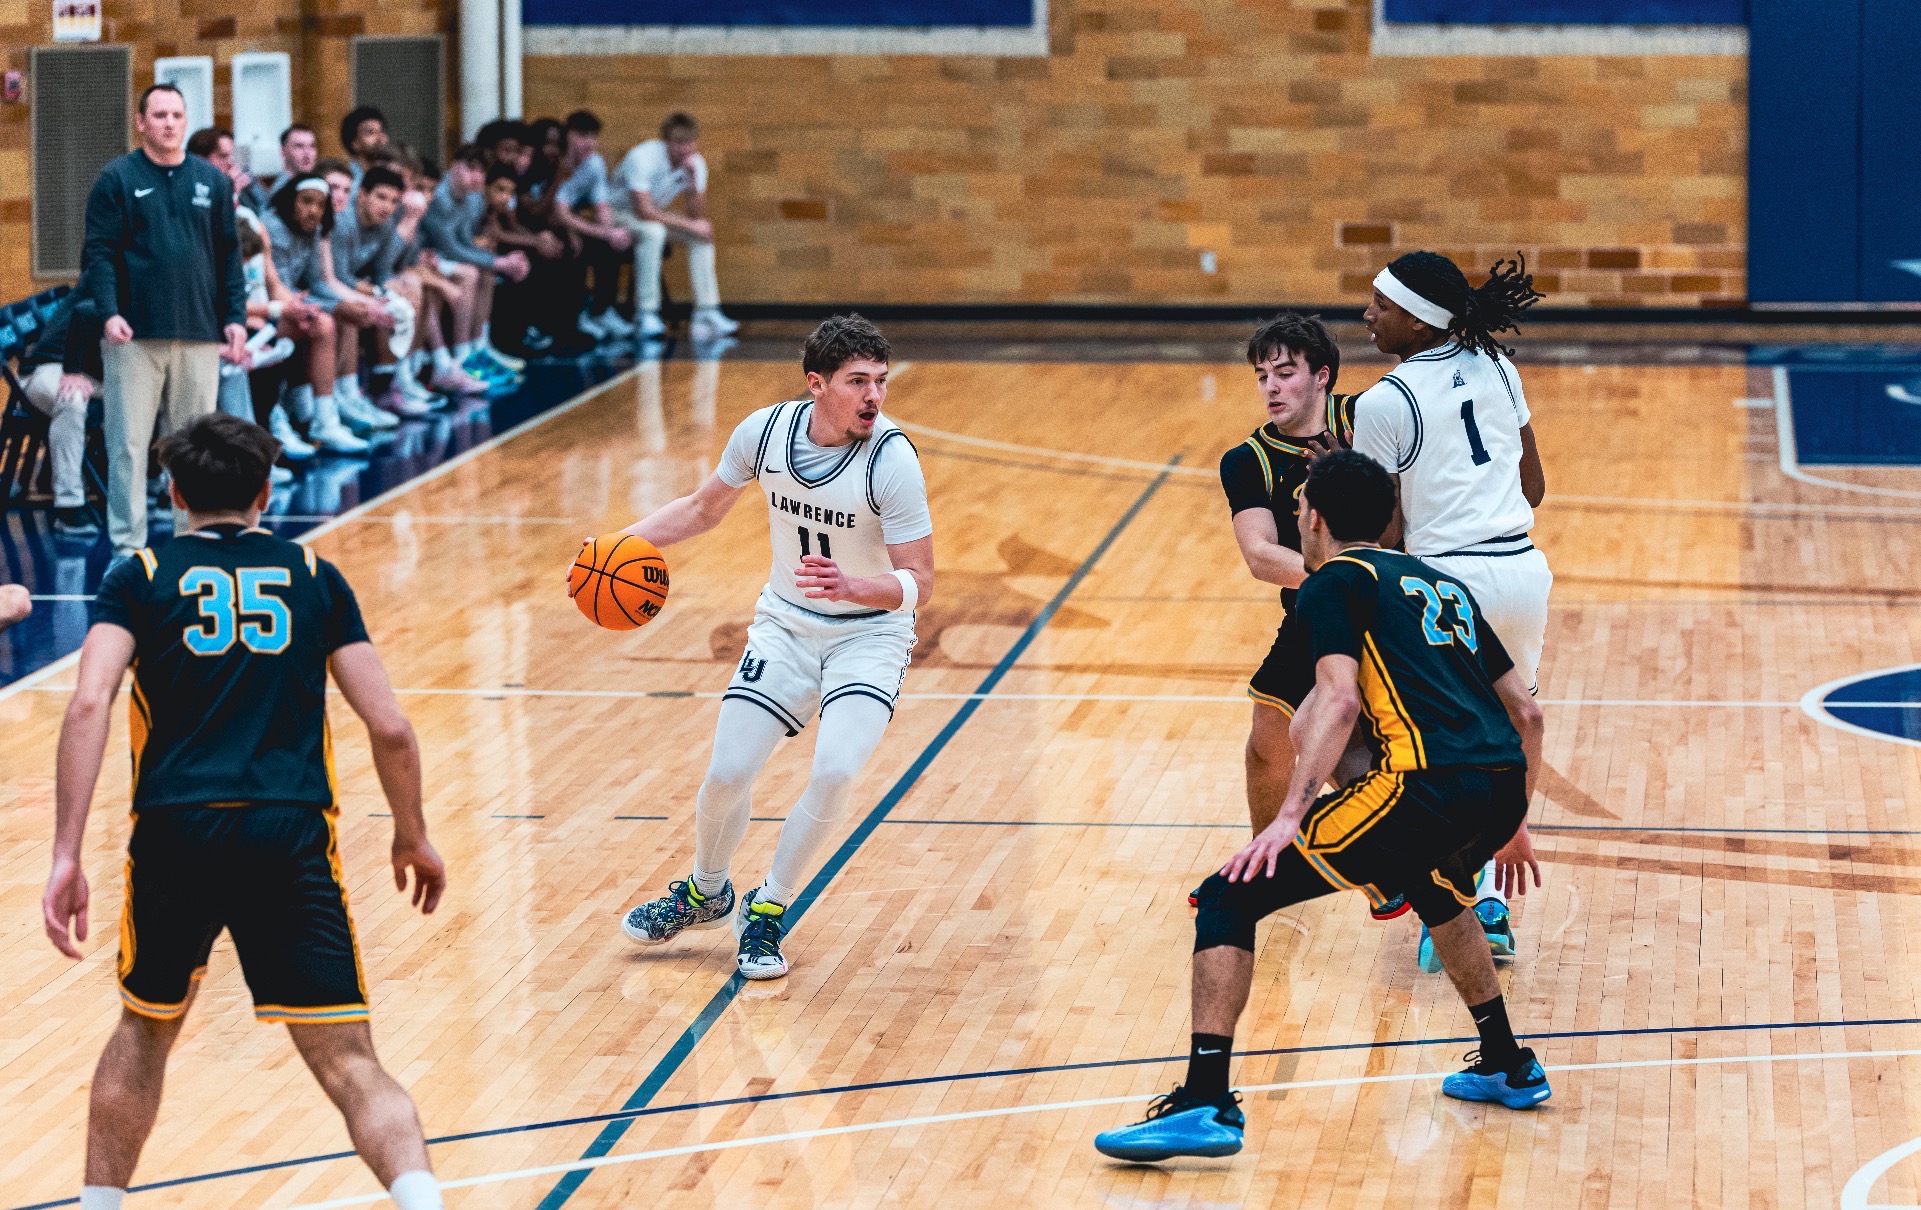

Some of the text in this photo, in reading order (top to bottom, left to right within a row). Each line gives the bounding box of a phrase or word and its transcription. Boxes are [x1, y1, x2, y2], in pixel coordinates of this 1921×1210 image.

[1460, 399, 1491, 466] 1
[771, 491, 856, 528] LAWRENCE
[798, 525, 832, 563] 11
[642, 565, 669, 587] Wil
[179, 566, 291, 656] 35
[638, 599, 662, 618] NC
[1400, 575, 1478, 655] 23
[738, 649, 769, 684] LU
